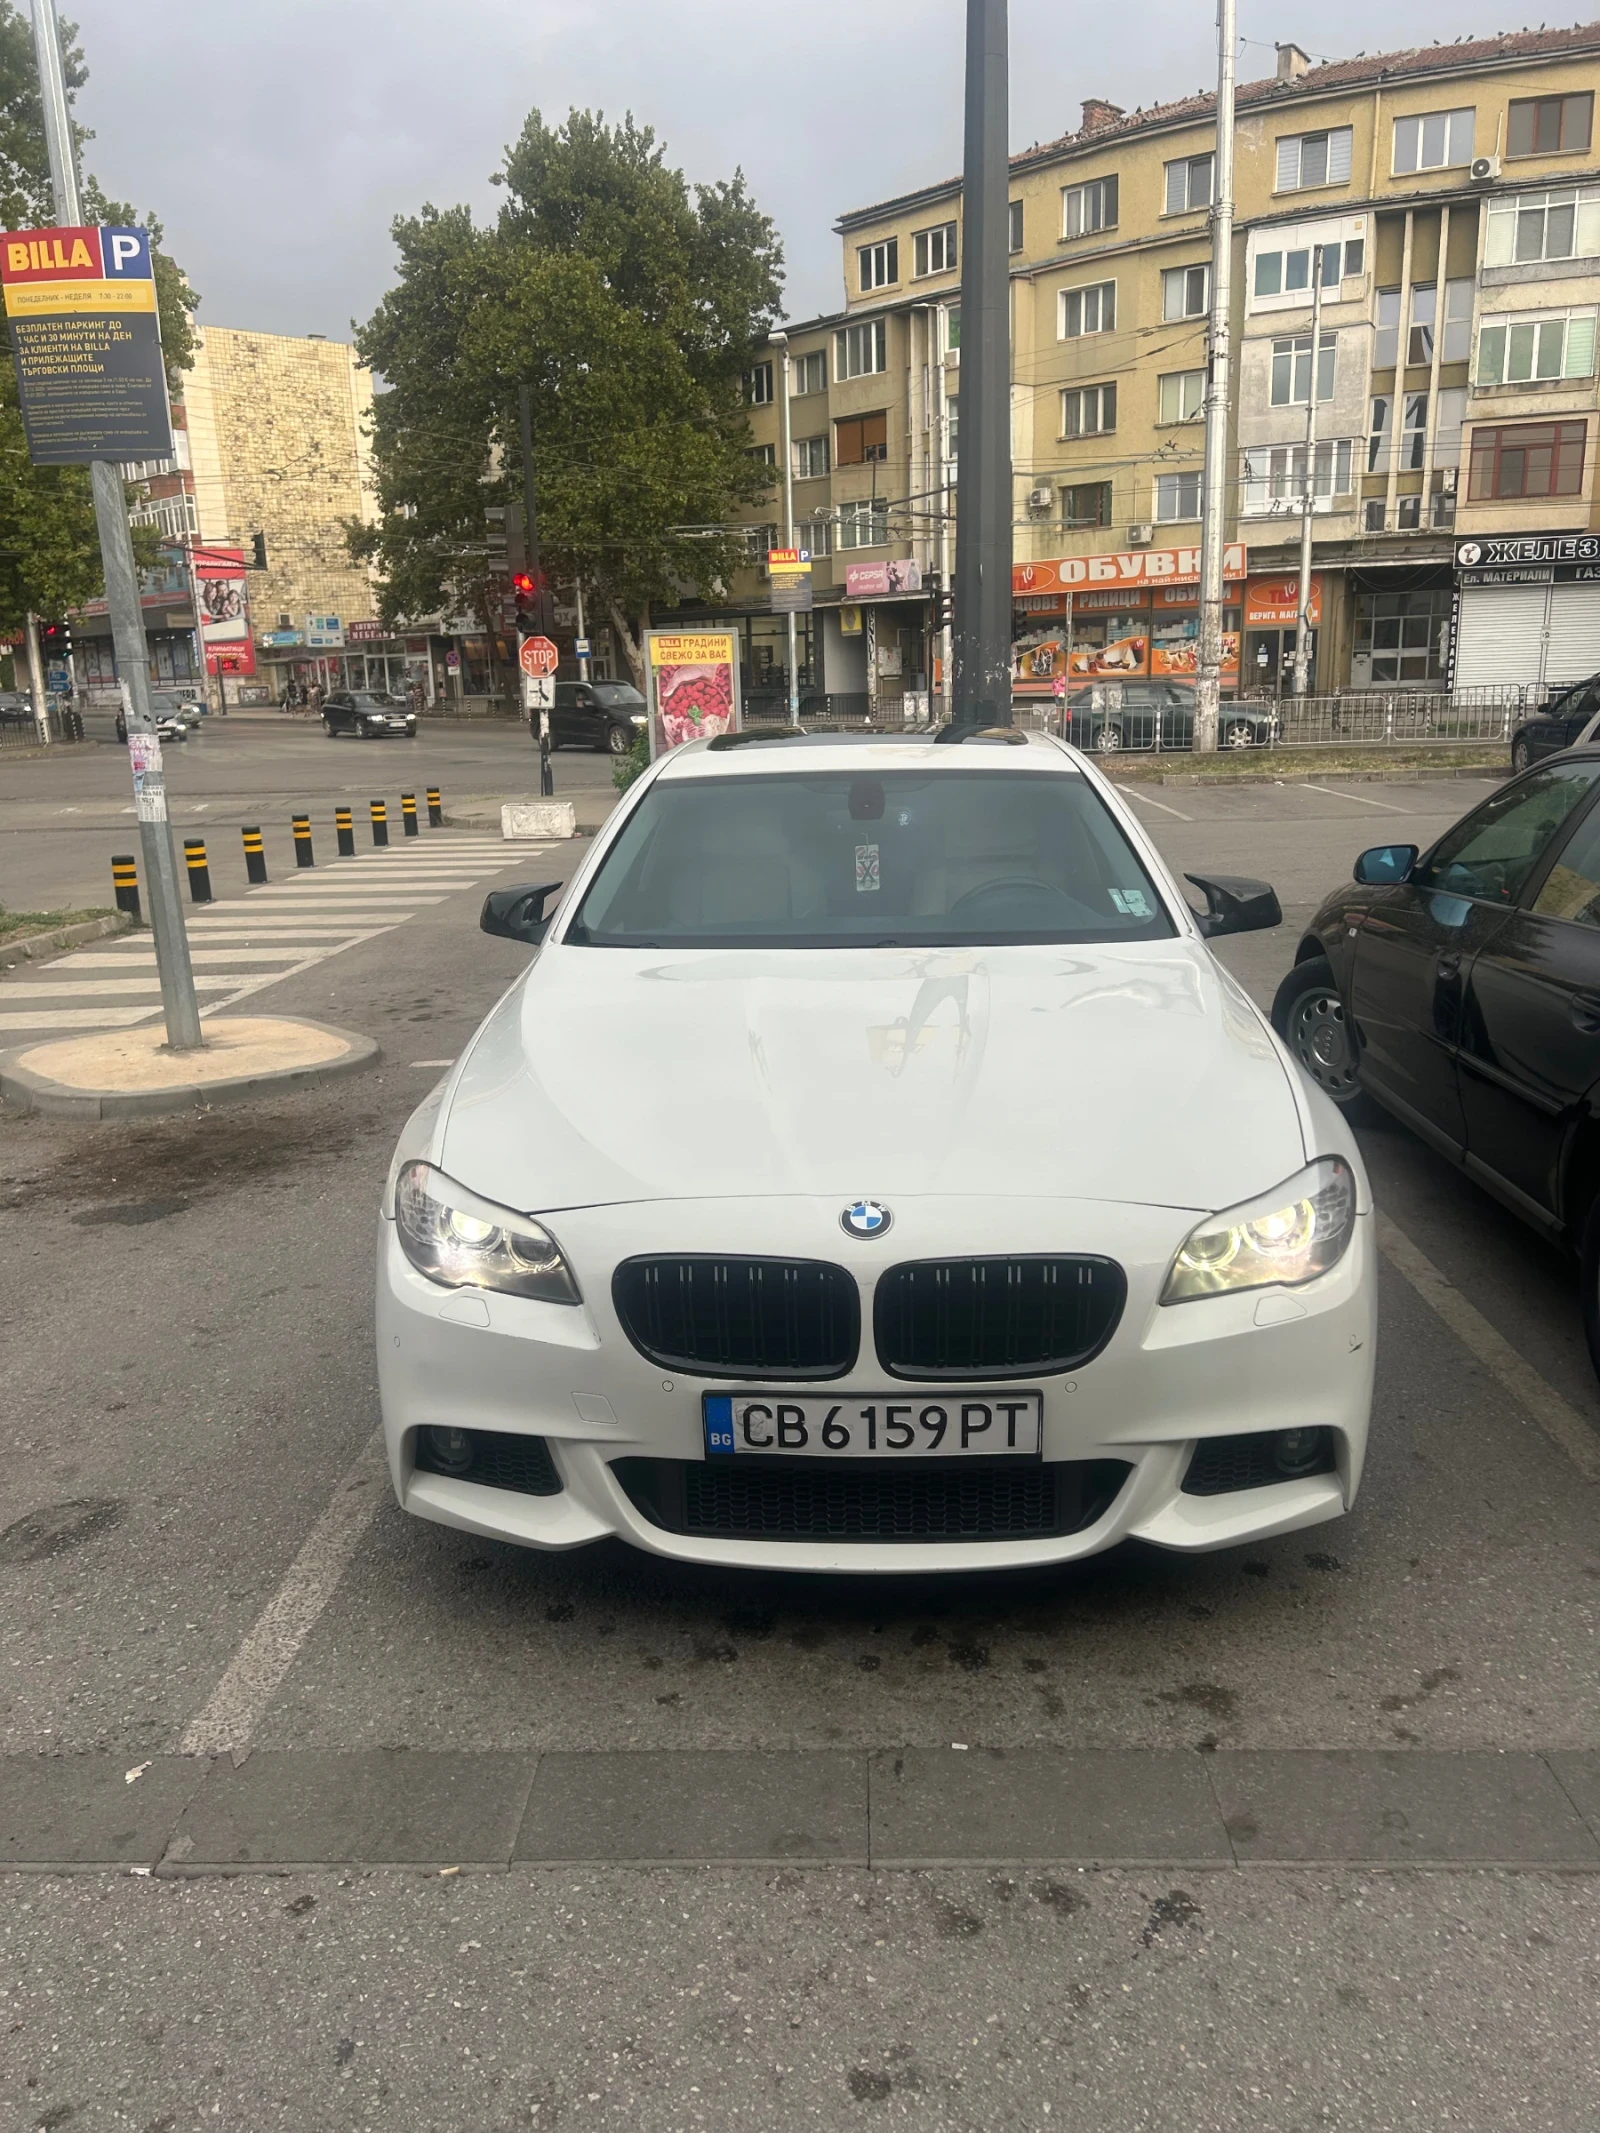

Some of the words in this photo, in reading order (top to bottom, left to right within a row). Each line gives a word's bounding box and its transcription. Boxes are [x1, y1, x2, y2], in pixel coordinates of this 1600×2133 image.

[7, 238, 94, 272] BILLA
[112, 234, 141, 271] P
[17, 294, 59, 304] ПОНЕДЕЛНИК
[64, 293, 92, 302] НЕДЕЛЯ
[15, 322, 63, 334] БЕЗПЛАТЕН
[65, 321, 106, 330] ПАРКИНГ
[108, 320, 122, 330] ДО
[18, 336, 22, 344] 1
[23, 335, 39, 344] ЧАС
[40, 335, 47, 343] И
[48, 334, 58, 342] 30
[60, 333, 96, 342] МИНУТИ
[98, 332, 111, 340] НА
[113, 332, 132, 341] ДЕН
[19, 347, 30, 356] ЗА
[31, 345, 69, 354] КЛИЕНТИ
[71, 344, 83, 352] НА
[85, 343, 110, 351] BILLA
[21, 358, 27, 366] И
[28, 354, 94, 366] ПРИЛЕЖАЩИТЕ
[22, 366, 69, 377] ТЪРГОВСКИ
[70, 365, 105, 374] ПЛОЩИ
[771, 551, 797, 562] BILLA
[800, 550, 809, 561] P
[1485, 539, 1600, 564] ЖЕЛЕЗ
[860, 569, 884, 580] CEPSA
[1152, 573, 1201, 584] най-ниск
[1463, 573, 1480, 584] Ел.
[1483, 569, 1550, 583] МАТЕРИАЛИ
[1284, 581, 1296, 598] 10
[1079, 590, 1141, 609] РАНИЦИ
[1249, 611, 1276, 620] ВЕРИГА
[659, 639, 680, 647] BILLA
[683, 638, 727, 648] ГРАДИНИ
[1446, 592, 1460, 689] ЖЕЛЕЗАРИЯ
[523, 649, 554, 665] STOP
[660, 651, 693, 660] СВЕЖО
[695, 651, 707, 659] ЗА
[709, 650, 727, 659] ВАС
[710, 1432, 732, 1446] BG
